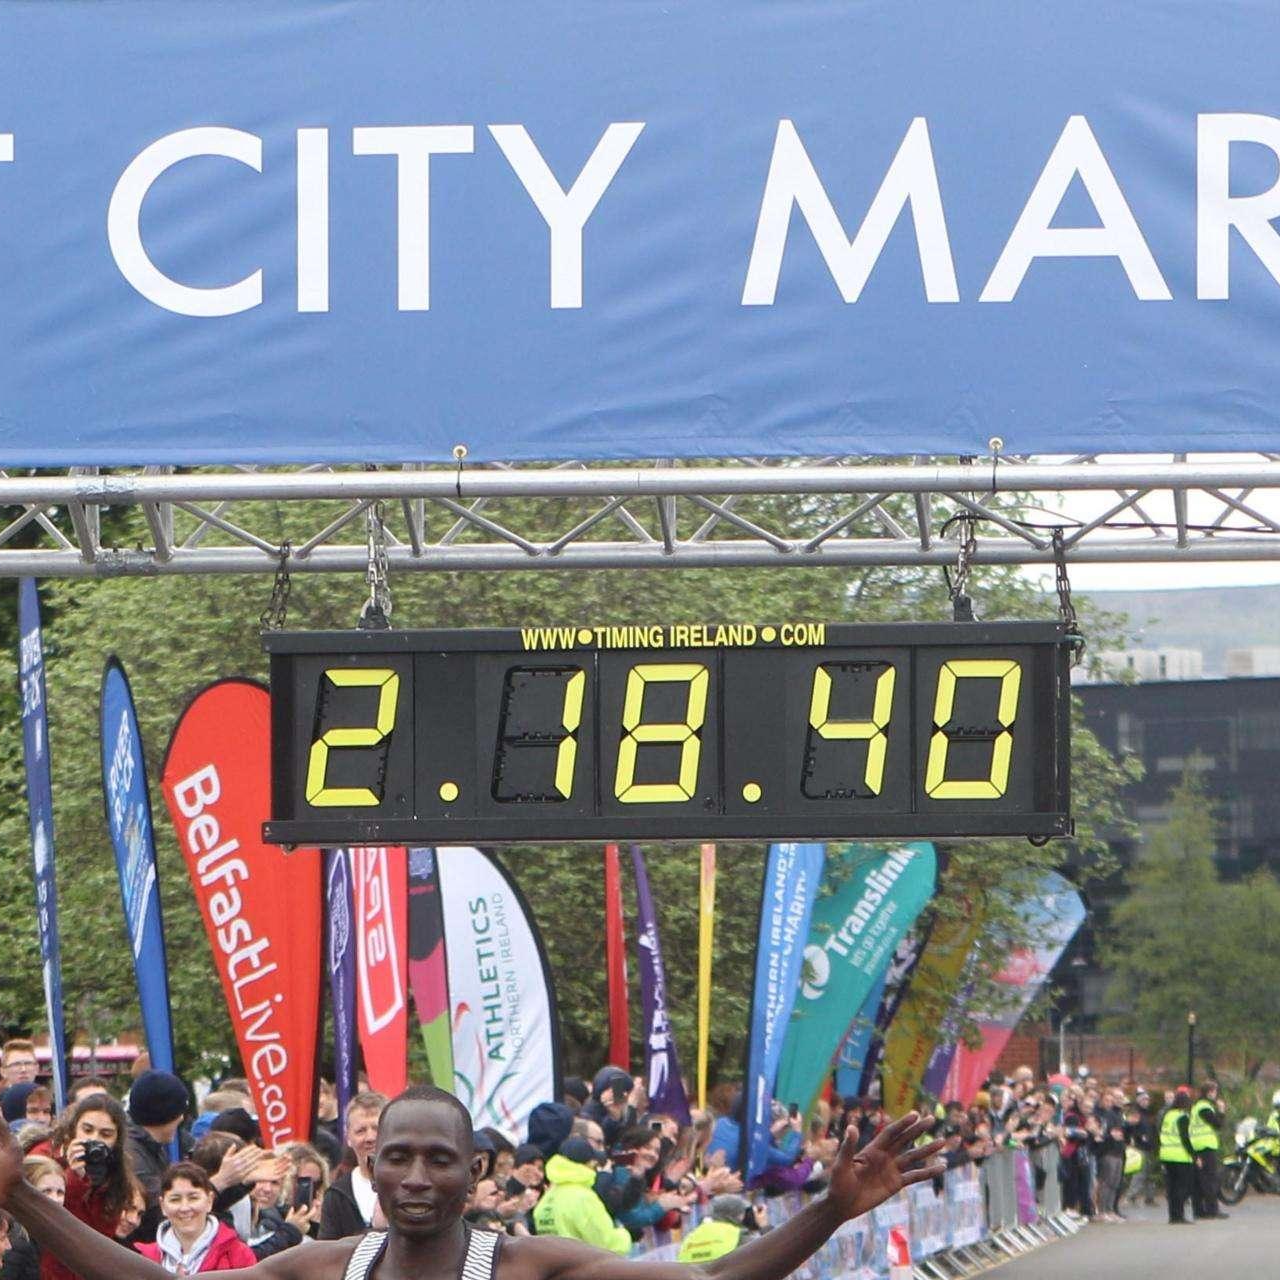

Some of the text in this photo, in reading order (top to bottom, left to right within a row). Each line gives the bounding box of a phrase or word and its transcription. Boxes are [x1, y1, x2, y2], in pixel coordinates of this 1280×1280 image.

[107, 121, 647, 318] CITY
[494, 892, 512, 964] IRELAND
[825, 848, 918, 958] Translink
[468, 895, 506, 1062] ATHLETICS
